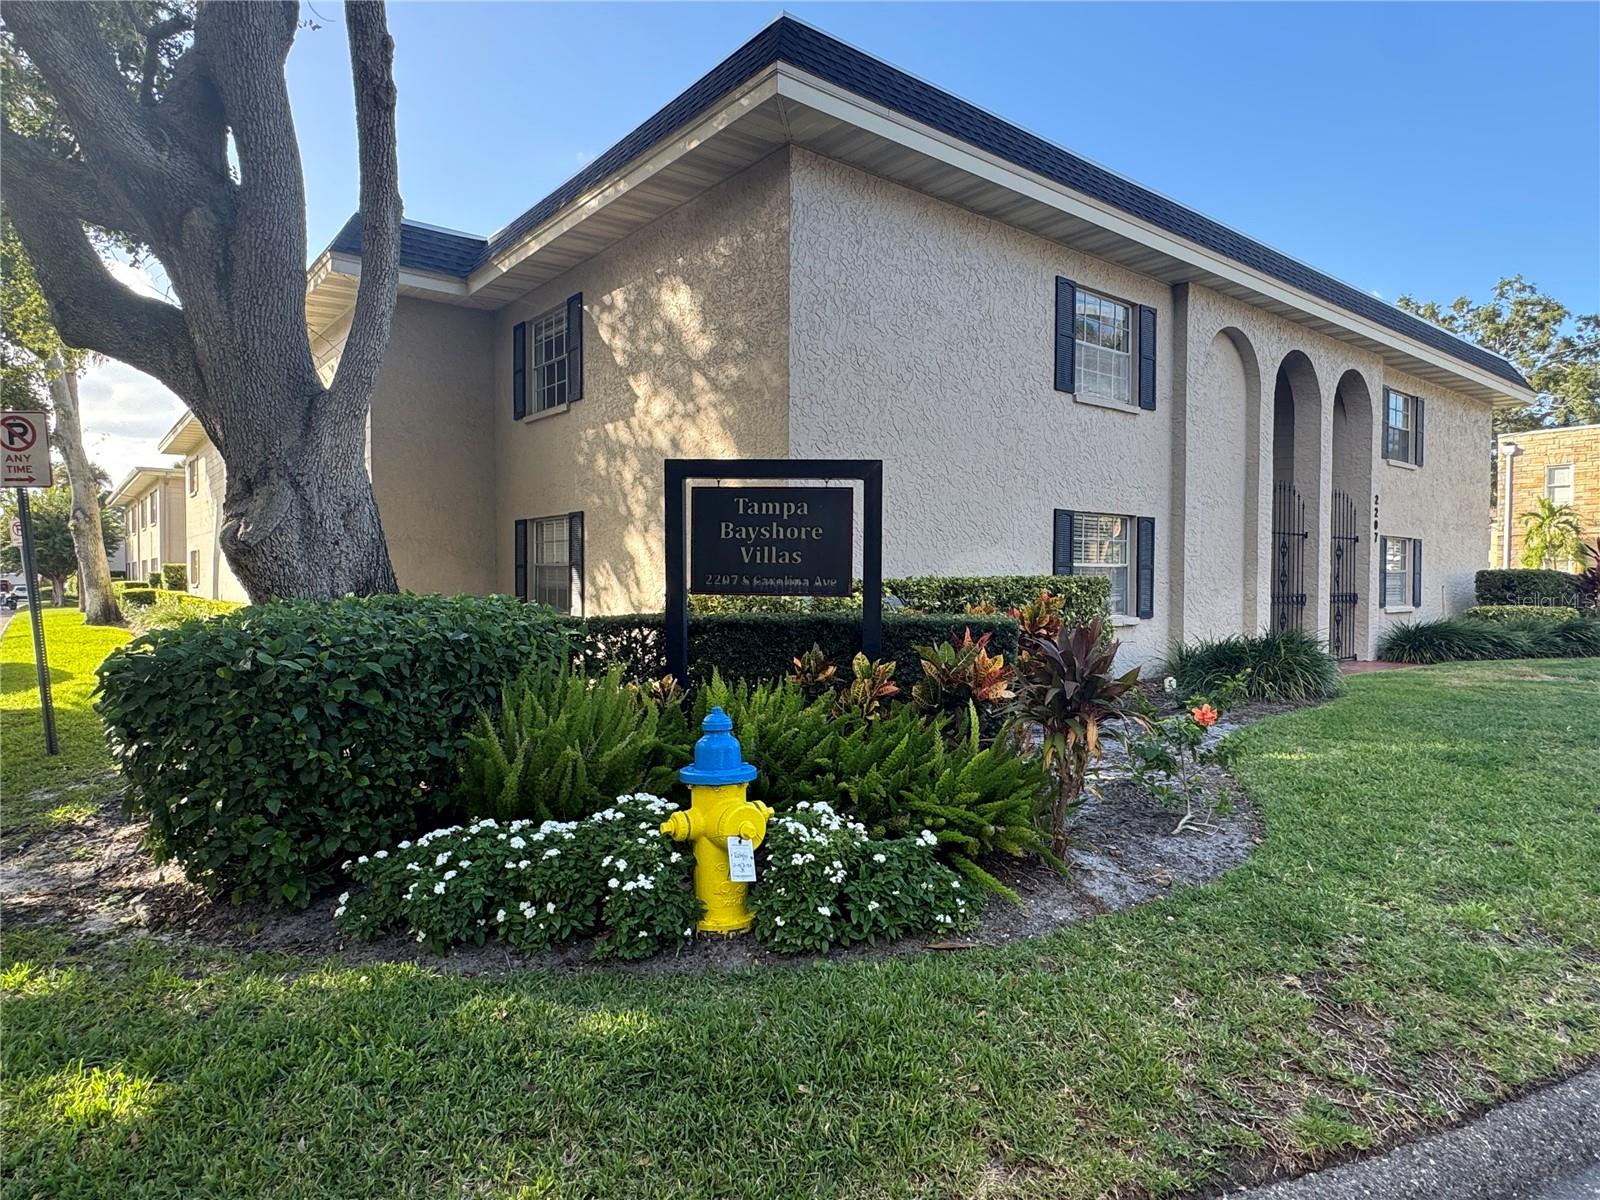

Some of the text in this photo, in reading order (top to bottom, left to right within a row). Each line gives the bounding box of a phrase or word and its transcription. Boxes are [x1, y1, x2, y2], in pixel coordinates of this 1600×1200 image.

[5, 454, 31, 463] ANY
[6, 465, 33, 474] TIME
[734, 497, 809, 520] Tampa
[720, 521, 823, 544] Bayshore
[740, 546, 802, 564] Villas
[705, 574, 738, 585] 2207
[742, 575, 750, 585] S
[814, 575, 838, 587] Ave
